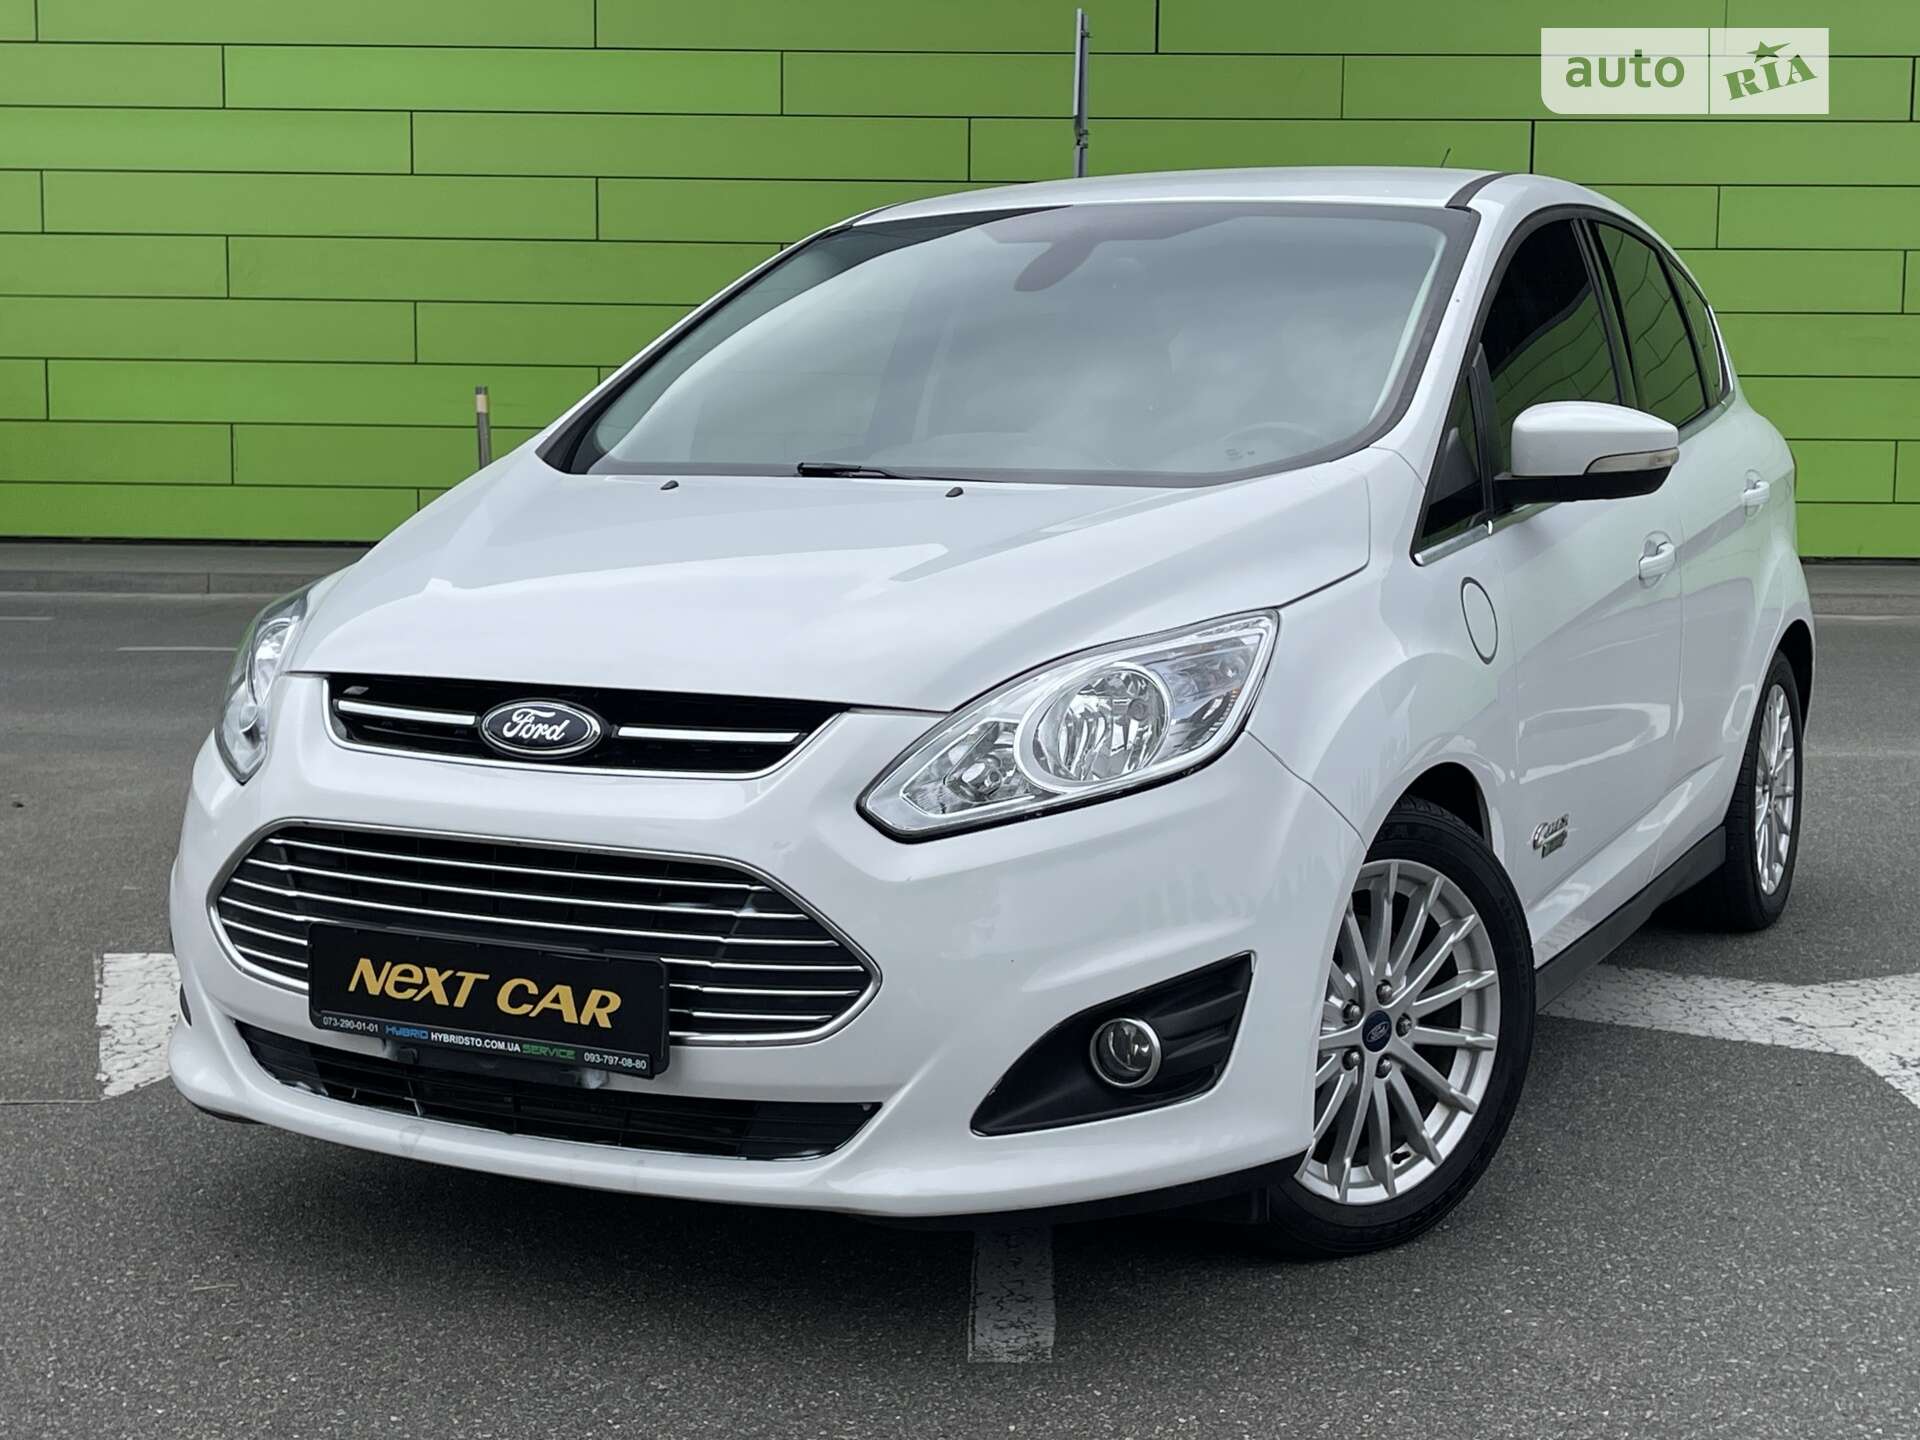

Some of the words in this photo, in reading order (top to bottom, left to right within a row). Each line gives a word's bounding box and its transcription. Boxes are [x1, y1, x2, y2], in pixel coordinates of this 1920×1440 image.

[503, 708, 570, 741] Ford
[497, 977, 622, 1029] CAR
[322, 1015, 379, 1033] 073-290-01-01
[430, 1031, 521, 1053] HYBRIDSTO.COM.UA
[522, 1043, 577, 1060] SERVICE
[583, 1051, 648, 1071] 093-797-08-80
